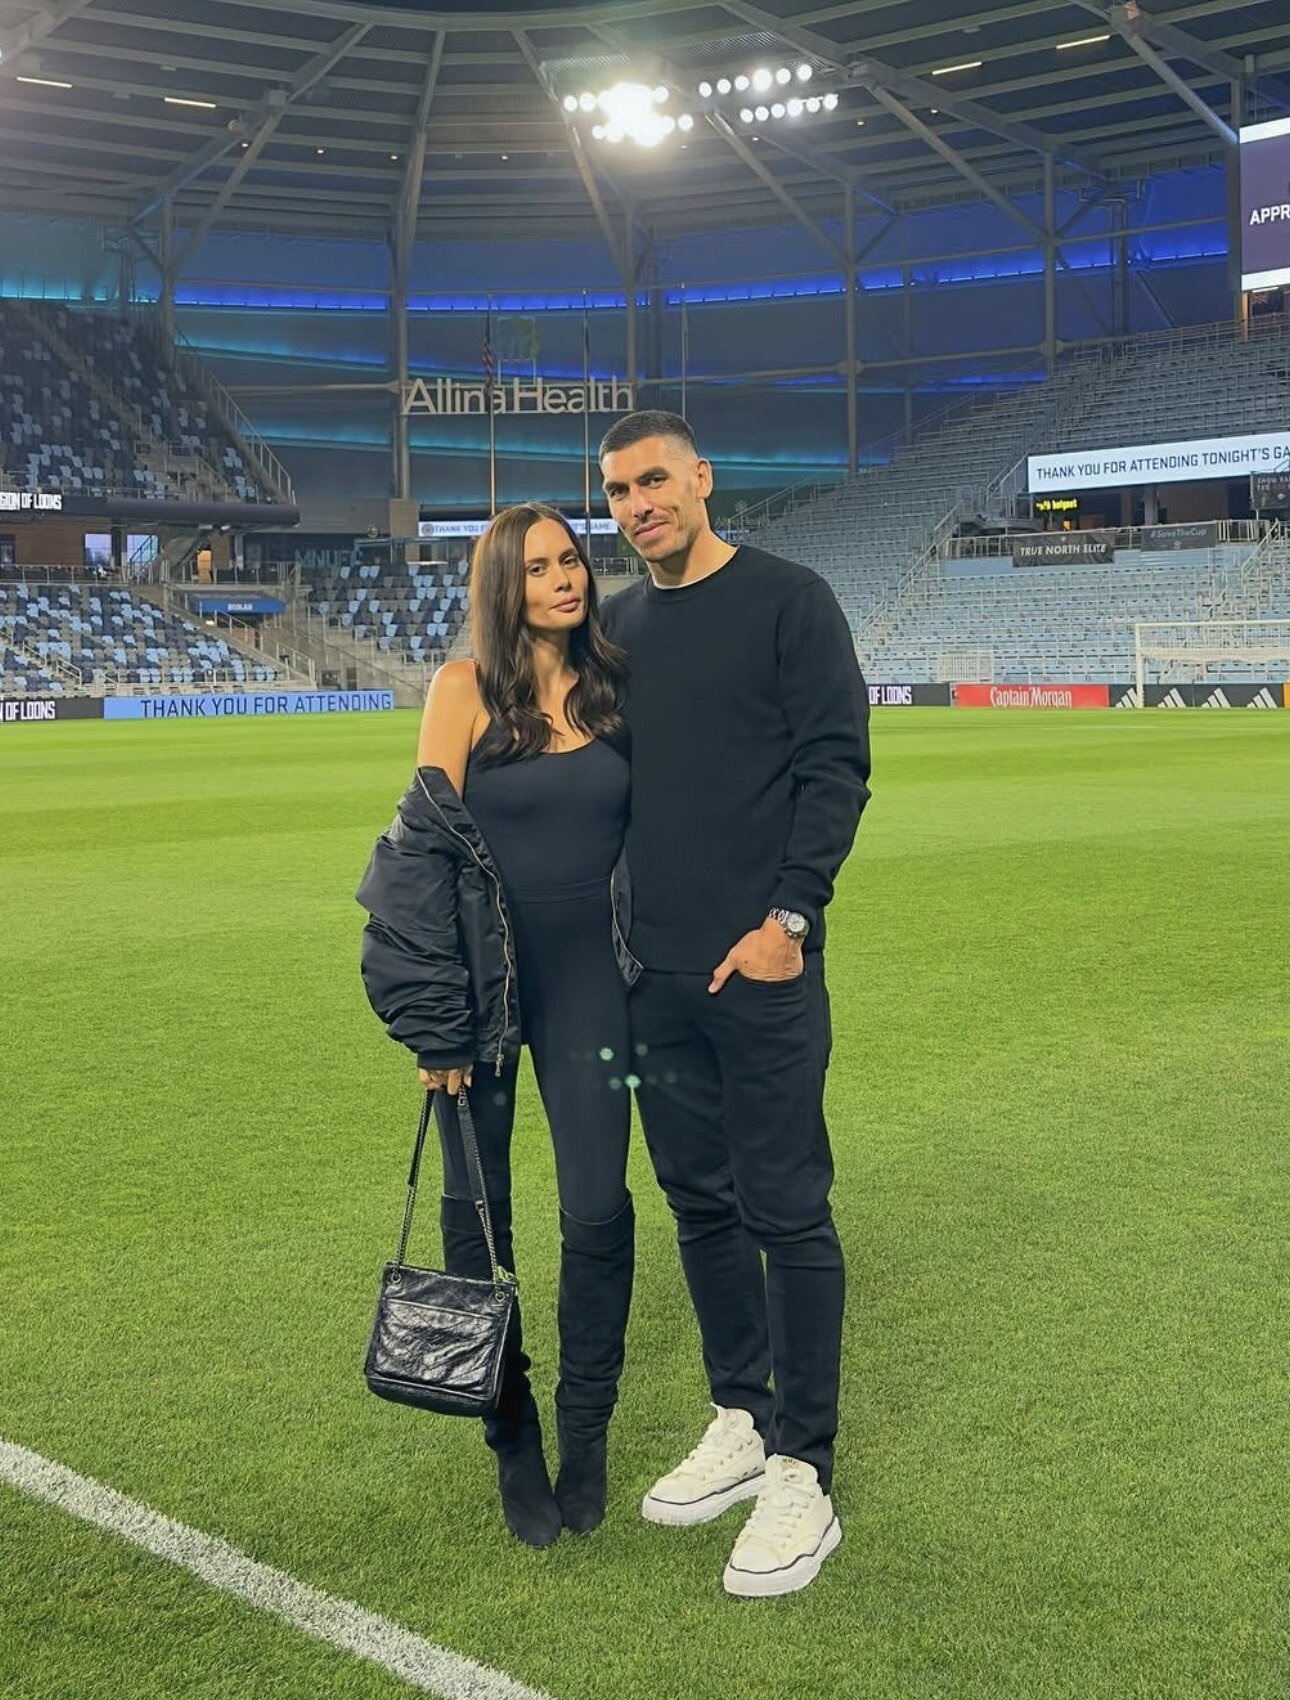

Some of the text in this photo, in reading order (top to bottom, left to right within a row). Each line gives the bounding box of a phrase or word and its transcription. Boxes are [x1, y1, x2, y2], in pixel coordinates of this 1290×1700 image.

[1249, 203, 1290, 226] APPR
[404, 375, 635, 415] Allina Health
[1036, 465, 1075, 480] THANK
[1077, 462, 1101, 477] YOU
[1103, 460, 1127, 475] FOR
[1129, 453, 1199, 472] ATTENDING
[1202, 446, 1271, 466] TONIGHT'S
[21, 492, 33, 509] OF
[33, 492, 63, 511] LOONS
[1020, 543, 1107, 557] TRUE NORTH ELITE
[140, 692, 392, 718] THANK YOU FOR ATTENDING
[868, 685, 913, 705] OF LOONS
[990, 686, 1073, 708] Captain Morgan
[5, 701, 20, 721] OF
[20, 700, 56, 720] LOONS
